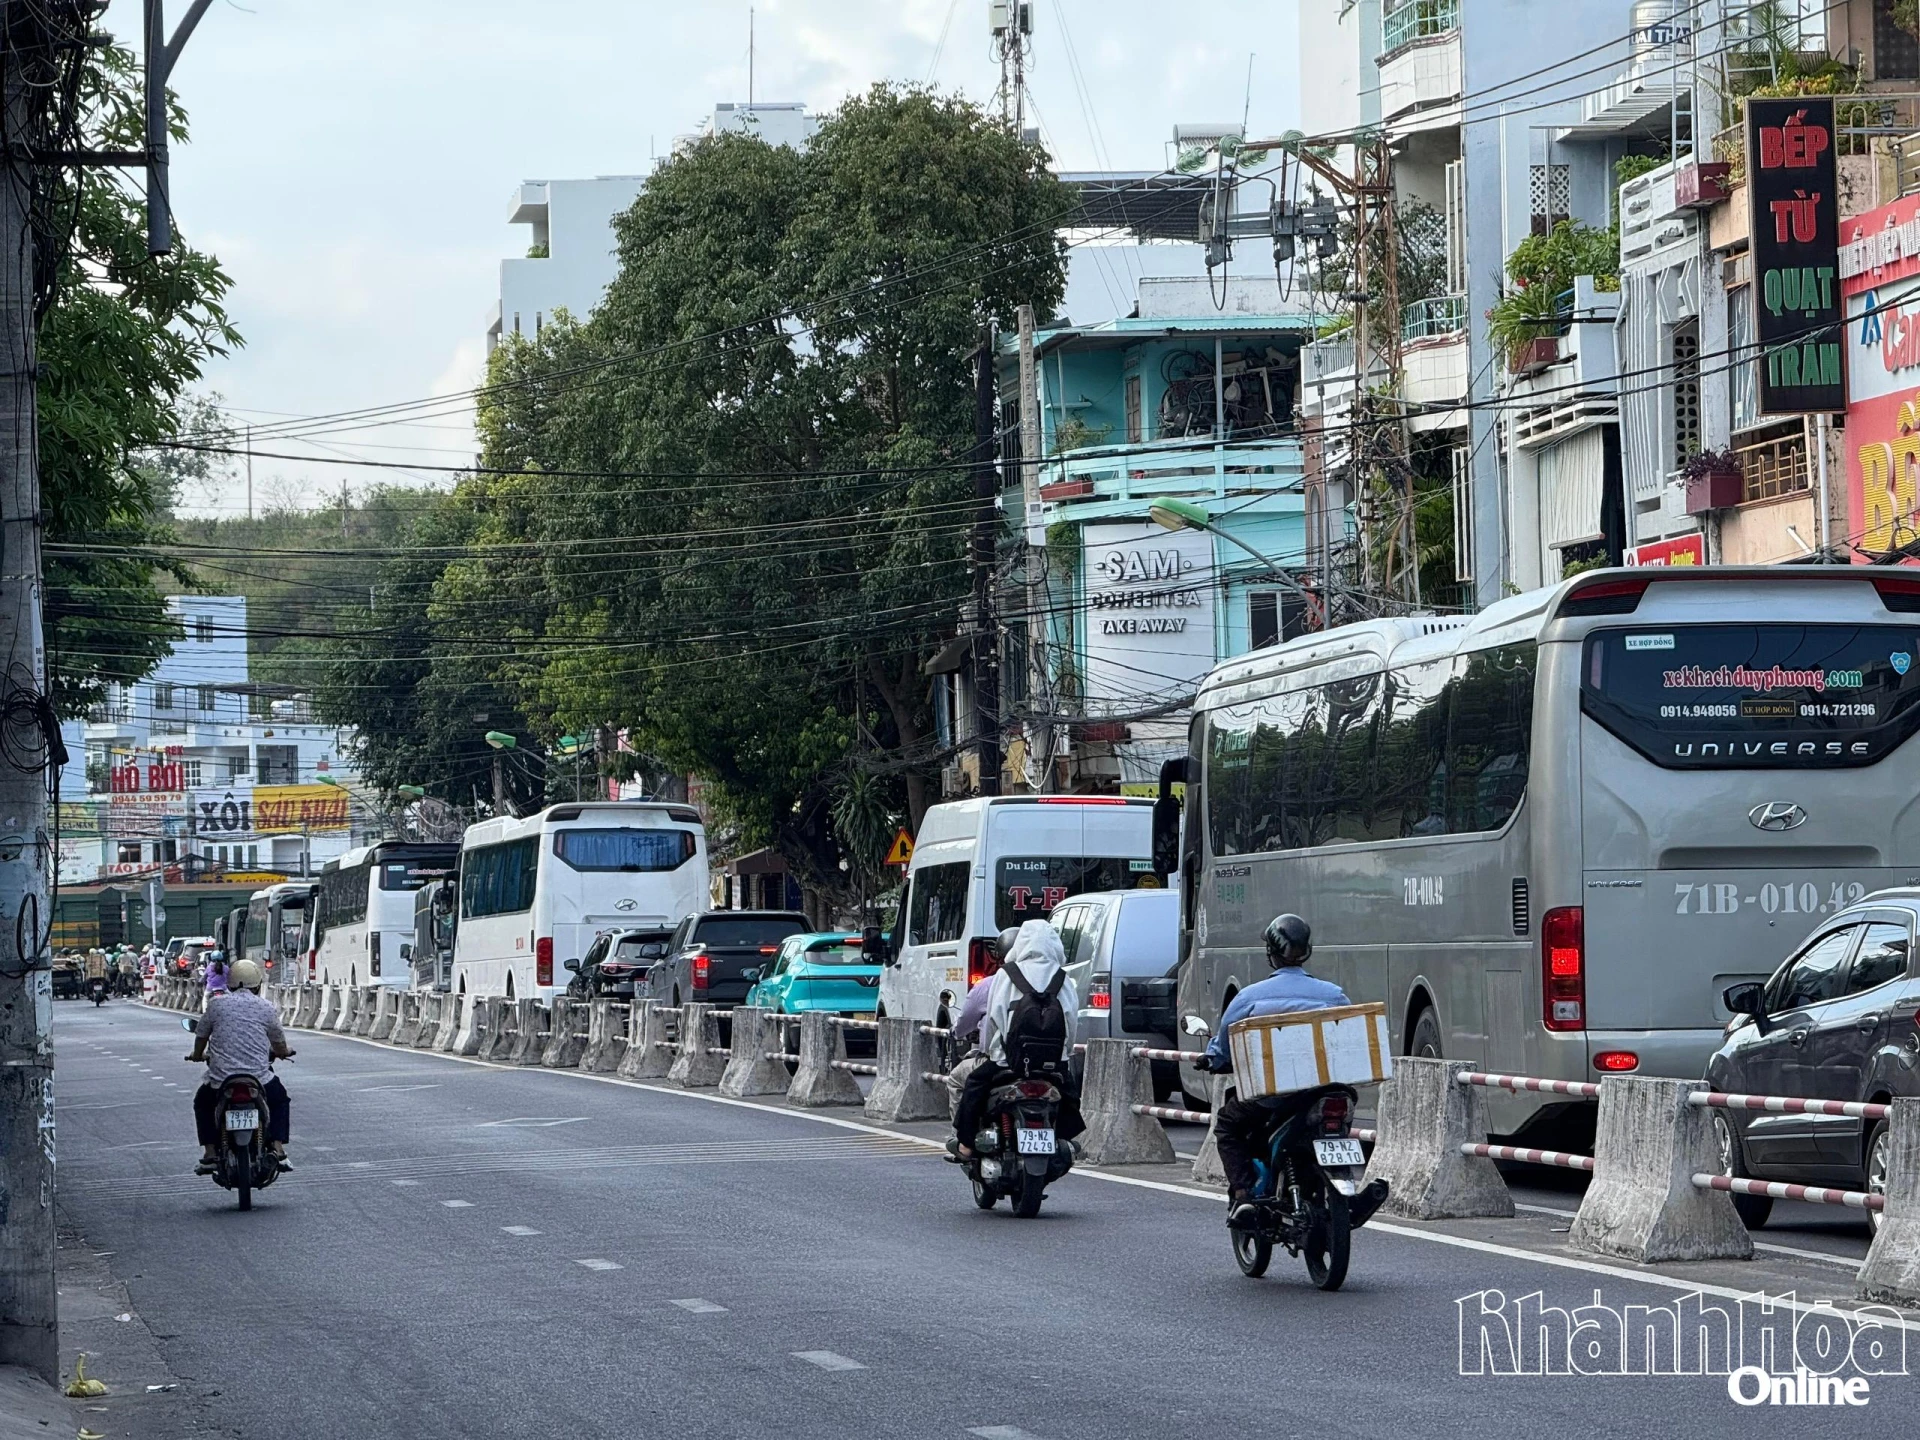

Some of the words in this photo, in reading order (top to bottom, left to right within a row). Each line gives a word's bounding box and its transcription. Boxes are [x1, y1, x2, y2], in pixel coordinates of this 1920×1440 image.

[1759, 109, 1829, 169] BẾP
[1770, 189, 1820, 244] TỪ
[1880, 212, 1901, 264] BẾP
[1764, 266, 1834, 318] QUẠT
[1104, 550, 1179, 581] SAM
[1100, 620, 1136, 634] TAKE
[1139, 617, 1186, 633] AWAY
[1663, 665, 1863, 692] xekhachduyphuong.com
[1660, 705, 1737, 718] 0914.948056
[1800, 704, 1876, 716] 0914.721296
[1675, 741, 1869, 756] UNIVERSE
[111, 755, 140, 793] HỒ
[148, 761, 185, 793] BƠI
[199, 791, 250, 831] XÔI
[1005, 862, 1021, 870] Du
[1023, 861, 1047, 872] Lịch
[1674, 882, 1865, 914] 71B-010.42
[230, 1119, 253, 1128] 1771
[1022, 1130, 1049, 1141] 79-N2
[1020, 1141, 1053, 1152] 724.29
[1320, 1141, 1355, 1152] 79-N2
[1320, 1152, 1361, 1164] 828.10
